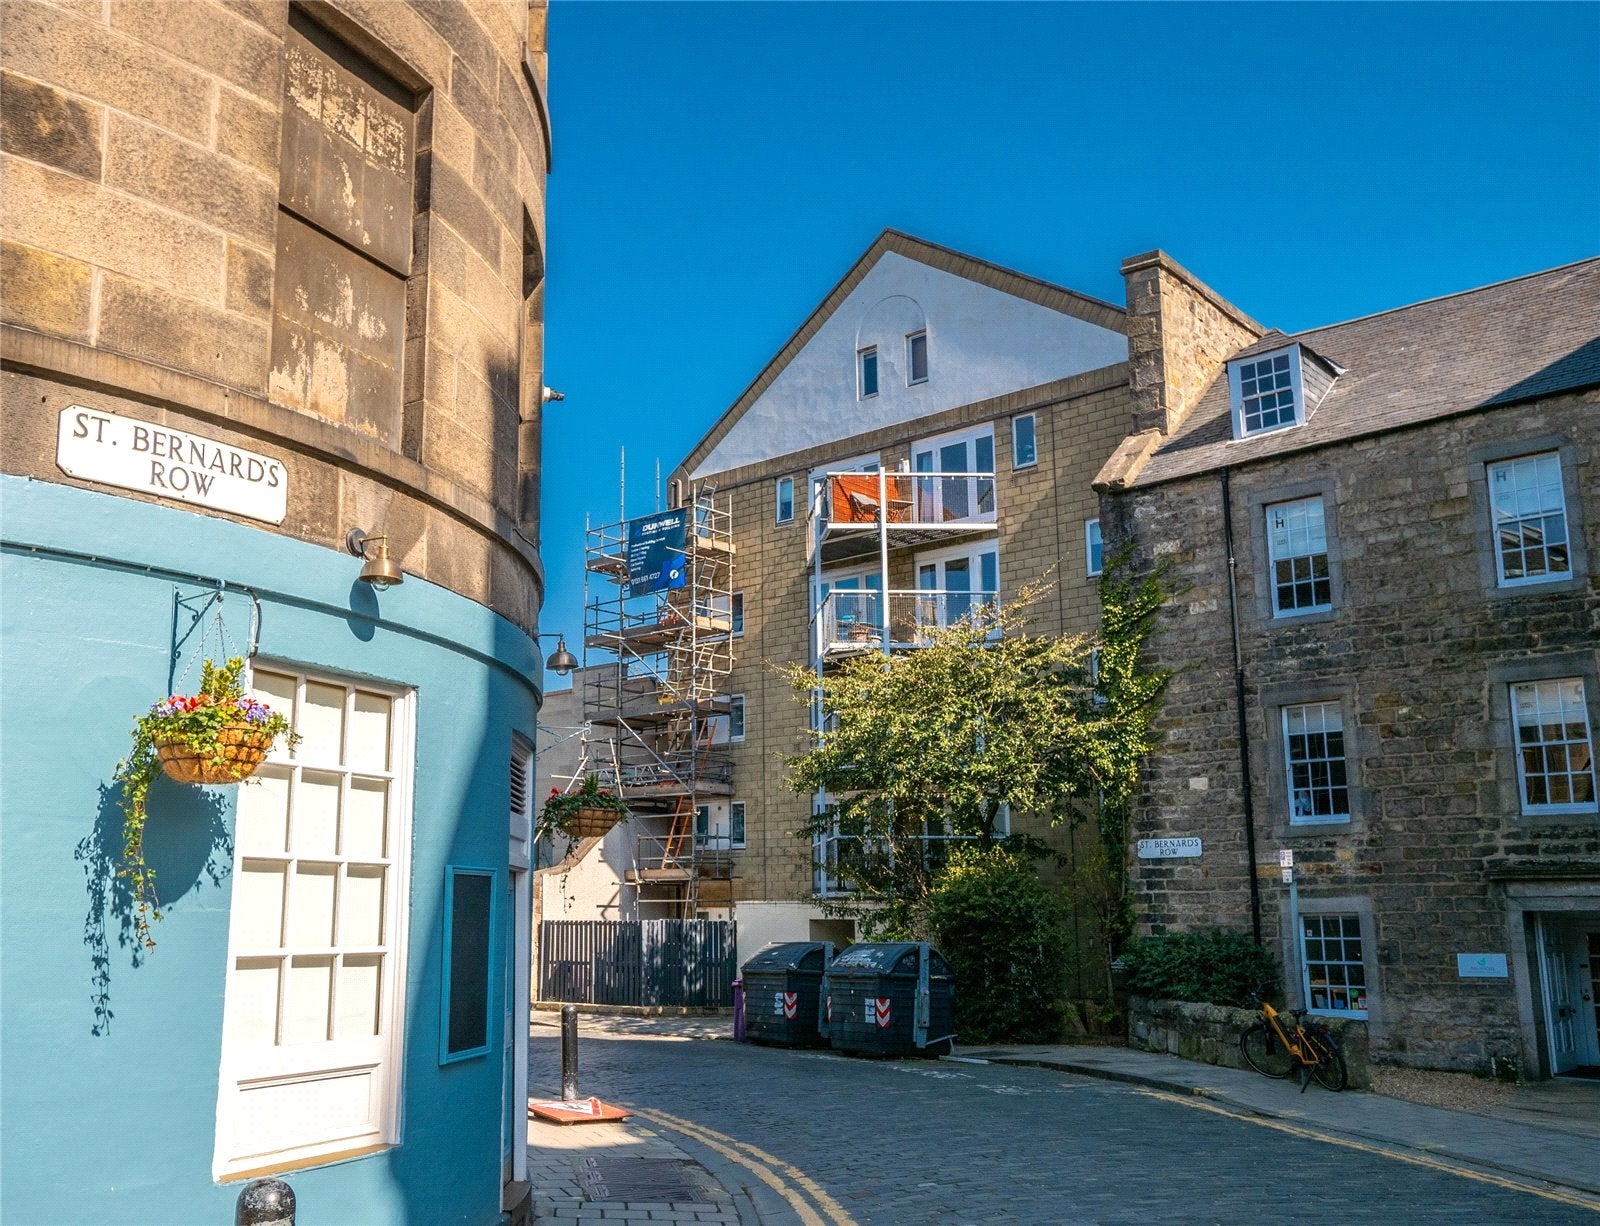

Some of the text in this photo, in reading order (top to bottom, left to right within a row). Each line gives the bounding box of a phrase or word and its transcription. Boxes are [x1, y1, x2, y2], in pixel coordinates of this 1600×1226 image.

[73, 412, 279, 487] ST. BERNARD'S
[149, 460, 216, 497] ROW
[1140, 840, 1152, 849] ST.
[1159, 848, 1178, 856] ROW
